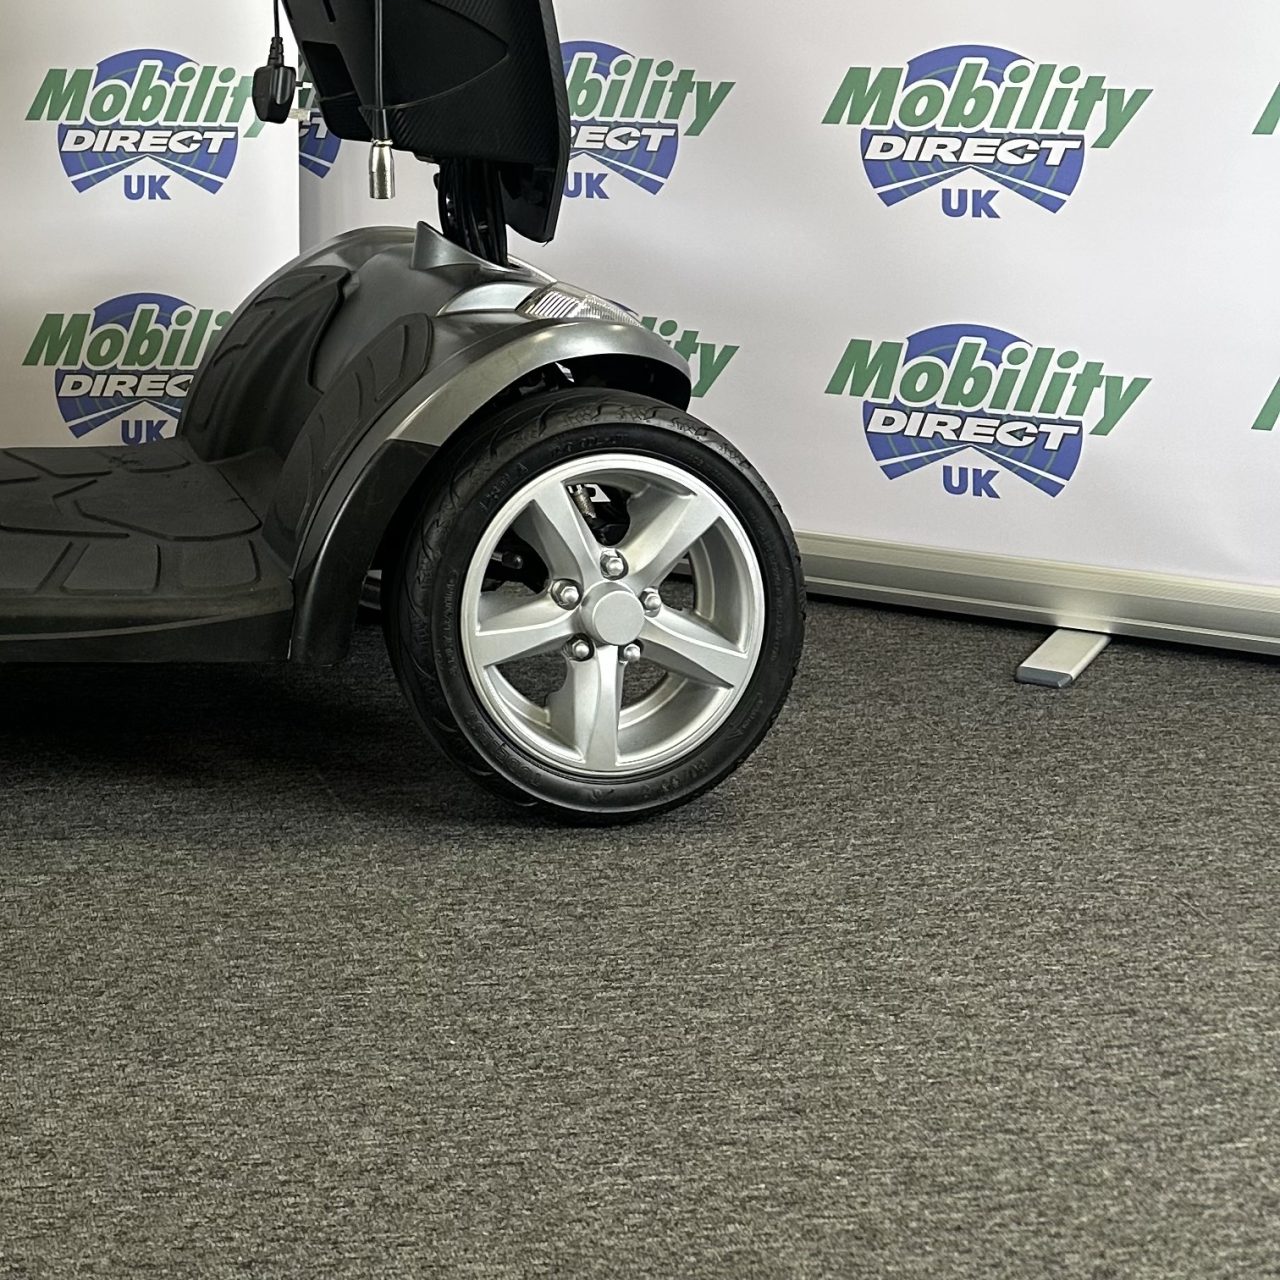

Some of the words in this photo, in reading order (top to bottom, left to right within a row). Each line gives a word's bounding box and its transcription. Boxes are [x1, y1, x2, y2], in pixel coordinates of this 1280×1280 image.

[24, 65, 266, 138] Mobilit
[568, 57, 736, 136] bility
[821, 62, 1154, 149] Mobility
[60, 129, 238, 154] DIRECT
[571, 125, 676, 152] ECT
[864, 134, 1082, 166] DIRECT
[123, 175, 171, 200] UK
[563, 172, 610, 200] UK
[941, 188, 1000, 219] UK
[22, 309, 233, 366] Mobili
[58, 374, 195, 398] DIREC
[824, 338, 1152, 437] Mobility
[121, 420, 169, 446] UK
[866, 407, 1080, 451] DIRECT
[942, 465, 1000, 499] UK
